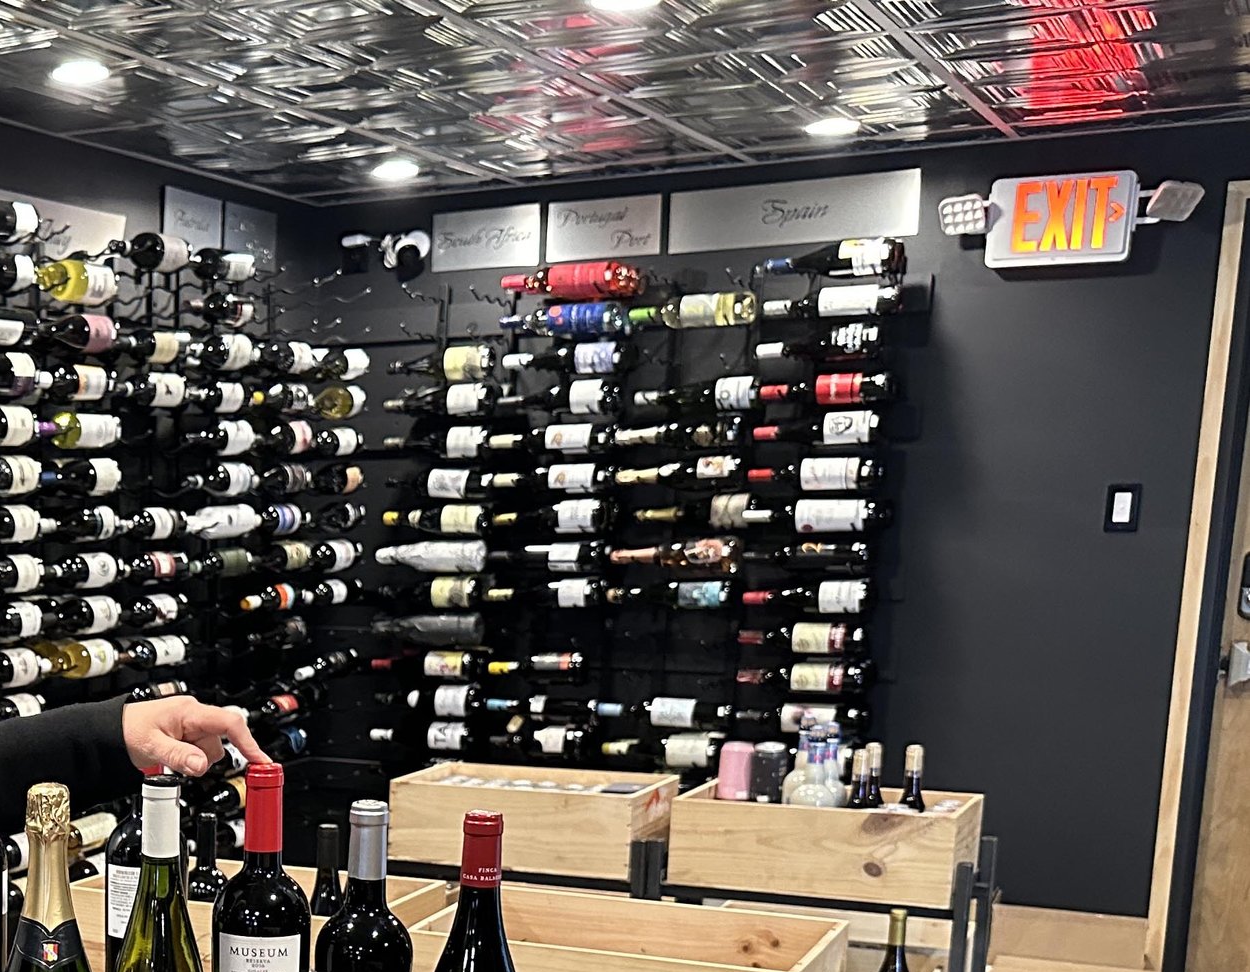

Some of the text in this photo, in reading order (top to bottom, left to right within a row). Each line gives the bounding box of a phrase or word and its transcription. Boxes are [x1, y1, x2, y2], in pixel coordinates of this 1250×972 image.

[556, 206, 629, 228] Portugal
[761, 199, 829, 228] Spain
[1011, 175, 1118, 253] EXIT
[610, 229, 651, 249] Port
[463, 873, 478, 881] CASA
[230, 946, 288, 957] MUSEUM
